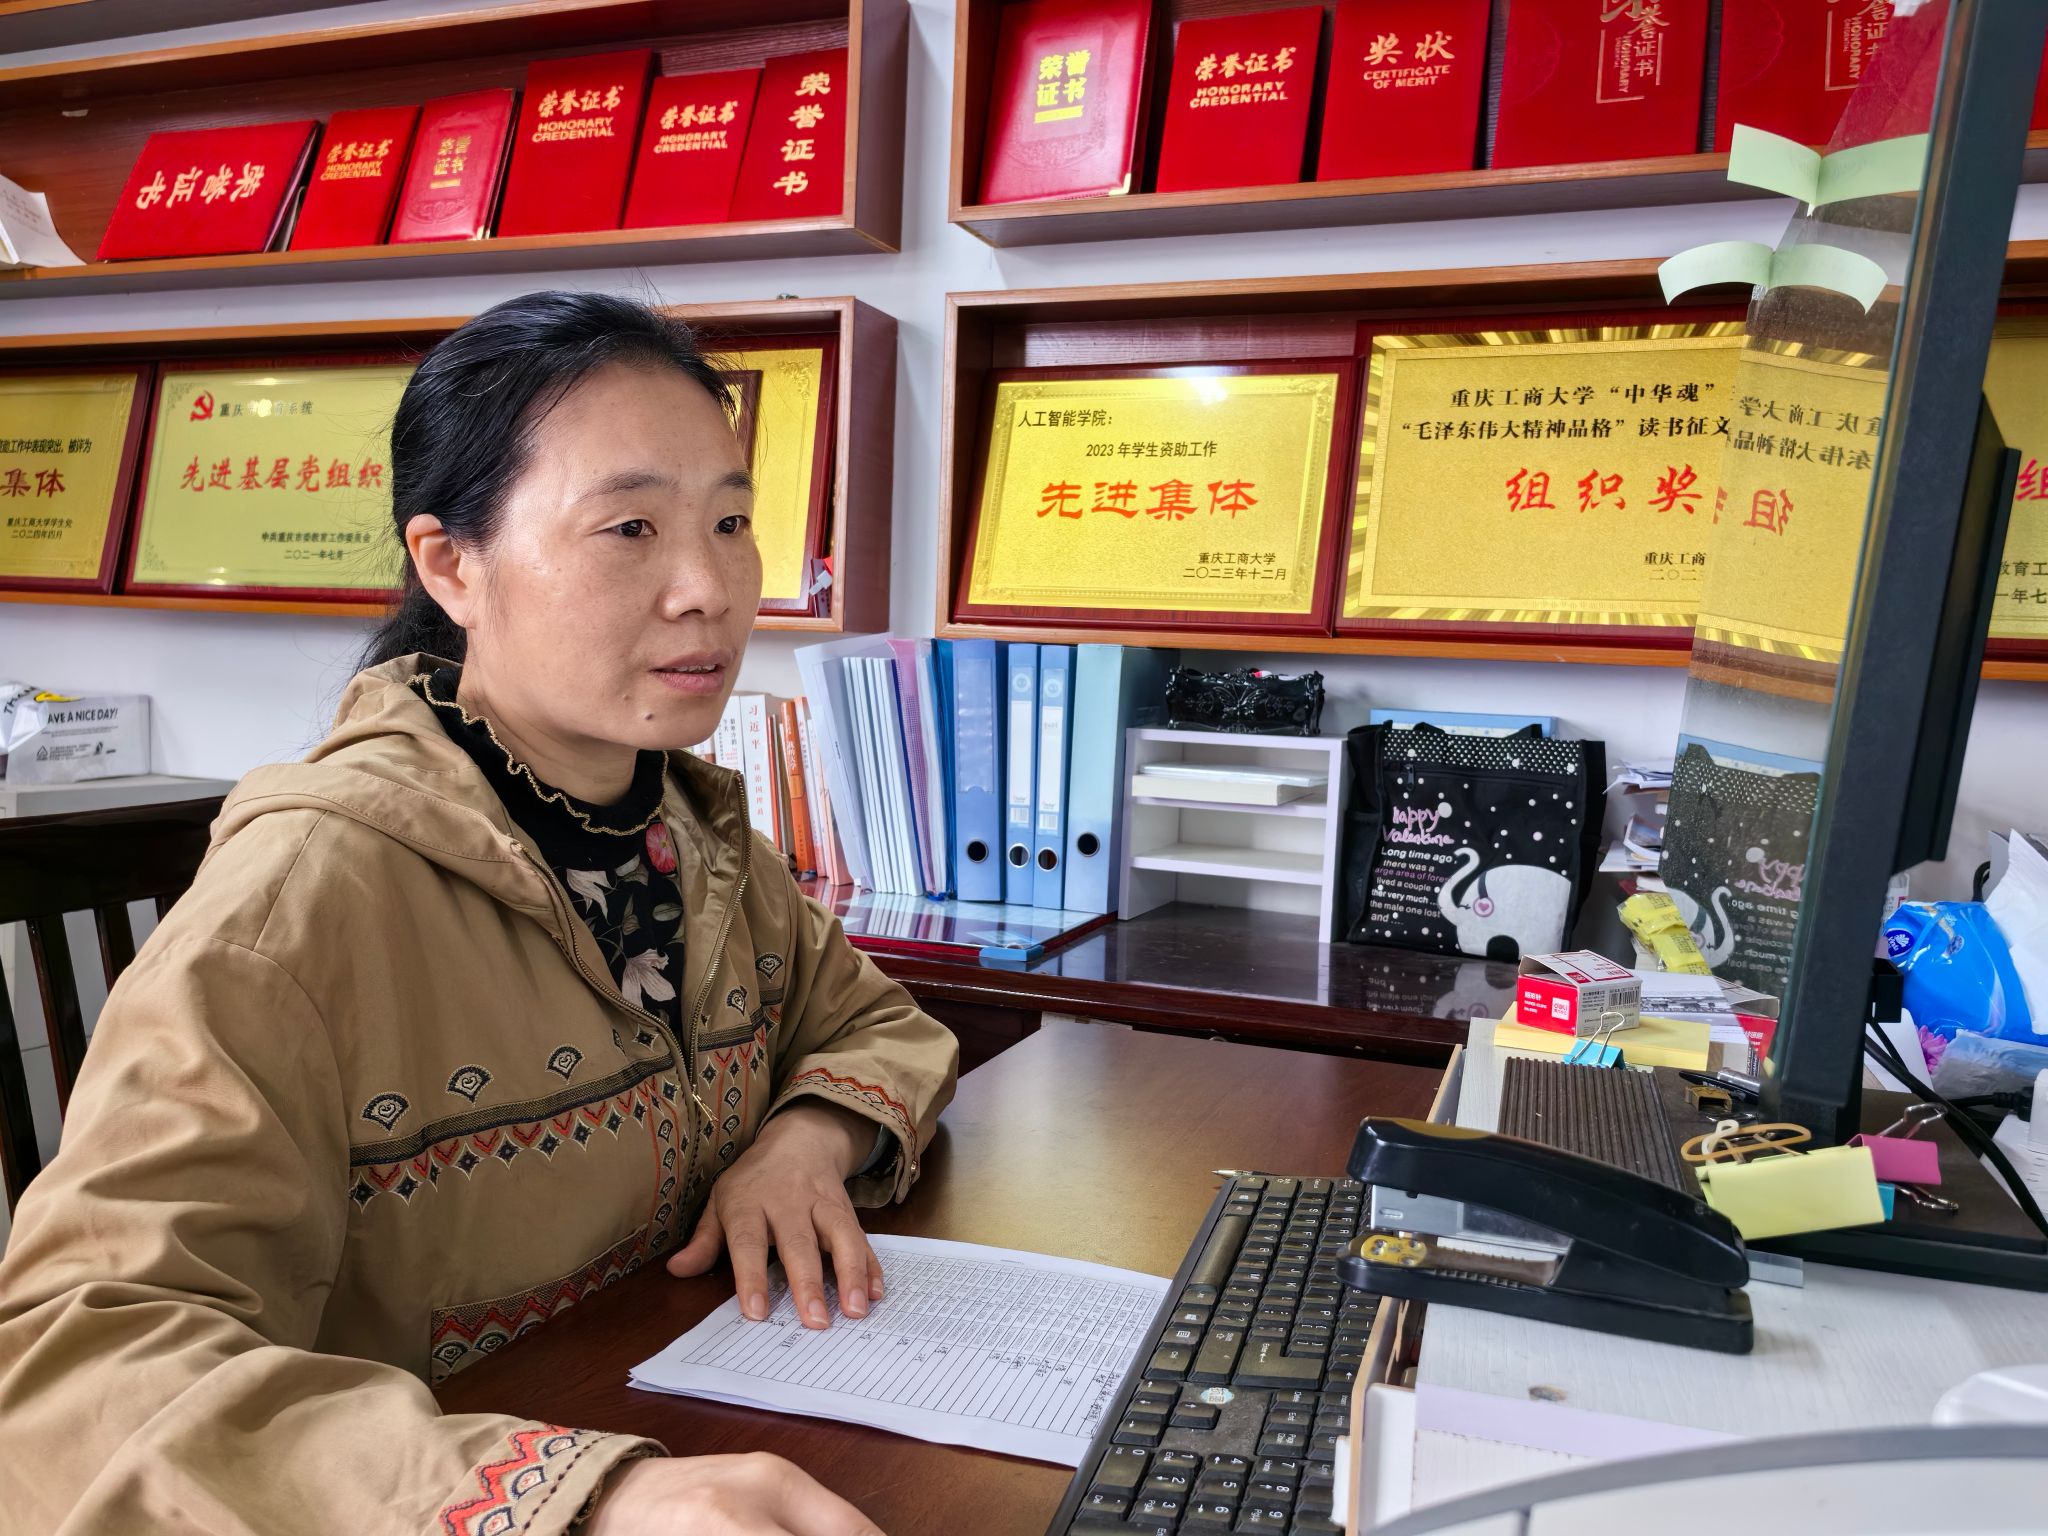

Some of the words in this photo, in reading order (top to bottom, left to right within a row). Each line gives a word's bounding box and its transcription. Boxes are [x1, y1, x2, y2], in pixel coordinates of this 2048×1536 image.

[1363, 31, 1455, 63] 奖状
[1194, 46, 1296, 82] 荣誉证书
[1363, 65, 1451, 81] CERTIFICATE
[1196, 80, 1285, 98] HONORARY
[1373, 78, 1396, 90] OF
[1399, 75, 1439, 88] MERIT
[537, 84, 624, 119] 荣誉证书
[1036, 79, 1086, 108] 证书
[1190, 92, 1288, 108] CREDENTIAL
[659, 100, 738, 130] 荣誉证书
[537, 116, 613, 133] HONORARY
[532, 126, 615, 143] CREDENTIAL
[659, 130, 727, 144] HONORARY
[773, 71, 831, 196] 荣誉证书
[326, 138, 393, 164] 荣誉证书
[654, 139, 728, 154] CREDENTIAL
[1018, 410, 1113, 427] 人工智能学院：
[180, 454, 384, 492] 先进基层党组织
[0, 467, 66, 498] 集体
[1505, 463, 1704, 514] 组织奖
[1036, 478, 1259, 521] 先进集体
[1198, 551, 1277, 566] 重庆工商大学
[1643, 551, 1706, 566] 重庆工商
[1649, 569, 1703, 582] 二〇二
[48, 712, 65, 724] AVE
[67, 711, 74, 723] A
[75, 709, 95, 722] NICE
[97, 707, 118, 721] DAY!
[748, 704, 761, 750] 习近平
[1381, 846, 1407, 859] Long
[1408, 850, 1431, 860] time
[1383, 860, 1407, 869] there
[1408, 863, 1427, 872] was
[1395, 871, 1415, 879] area
[1417, 872, 1426, 880] of
[1376, 876, 1396, 887] lived
[1403, 881, 1431, 893] couple
[1387, 891, 1405, 902] very
[1405, 894, 1429, 904] much
[1369, 899, 1383, 909] the
[1383, 902, 1405, 912] male
[1405, 906, 1423, 915] one
[1370, 913, 1390, 922] and
[1230, 1457, 1244, 1465] 4
[1171, 1476, 1185, 1484] 2
[1276, 1485, 1290, 1493] 8
[1162, 1501, 1176, 1509] 3
